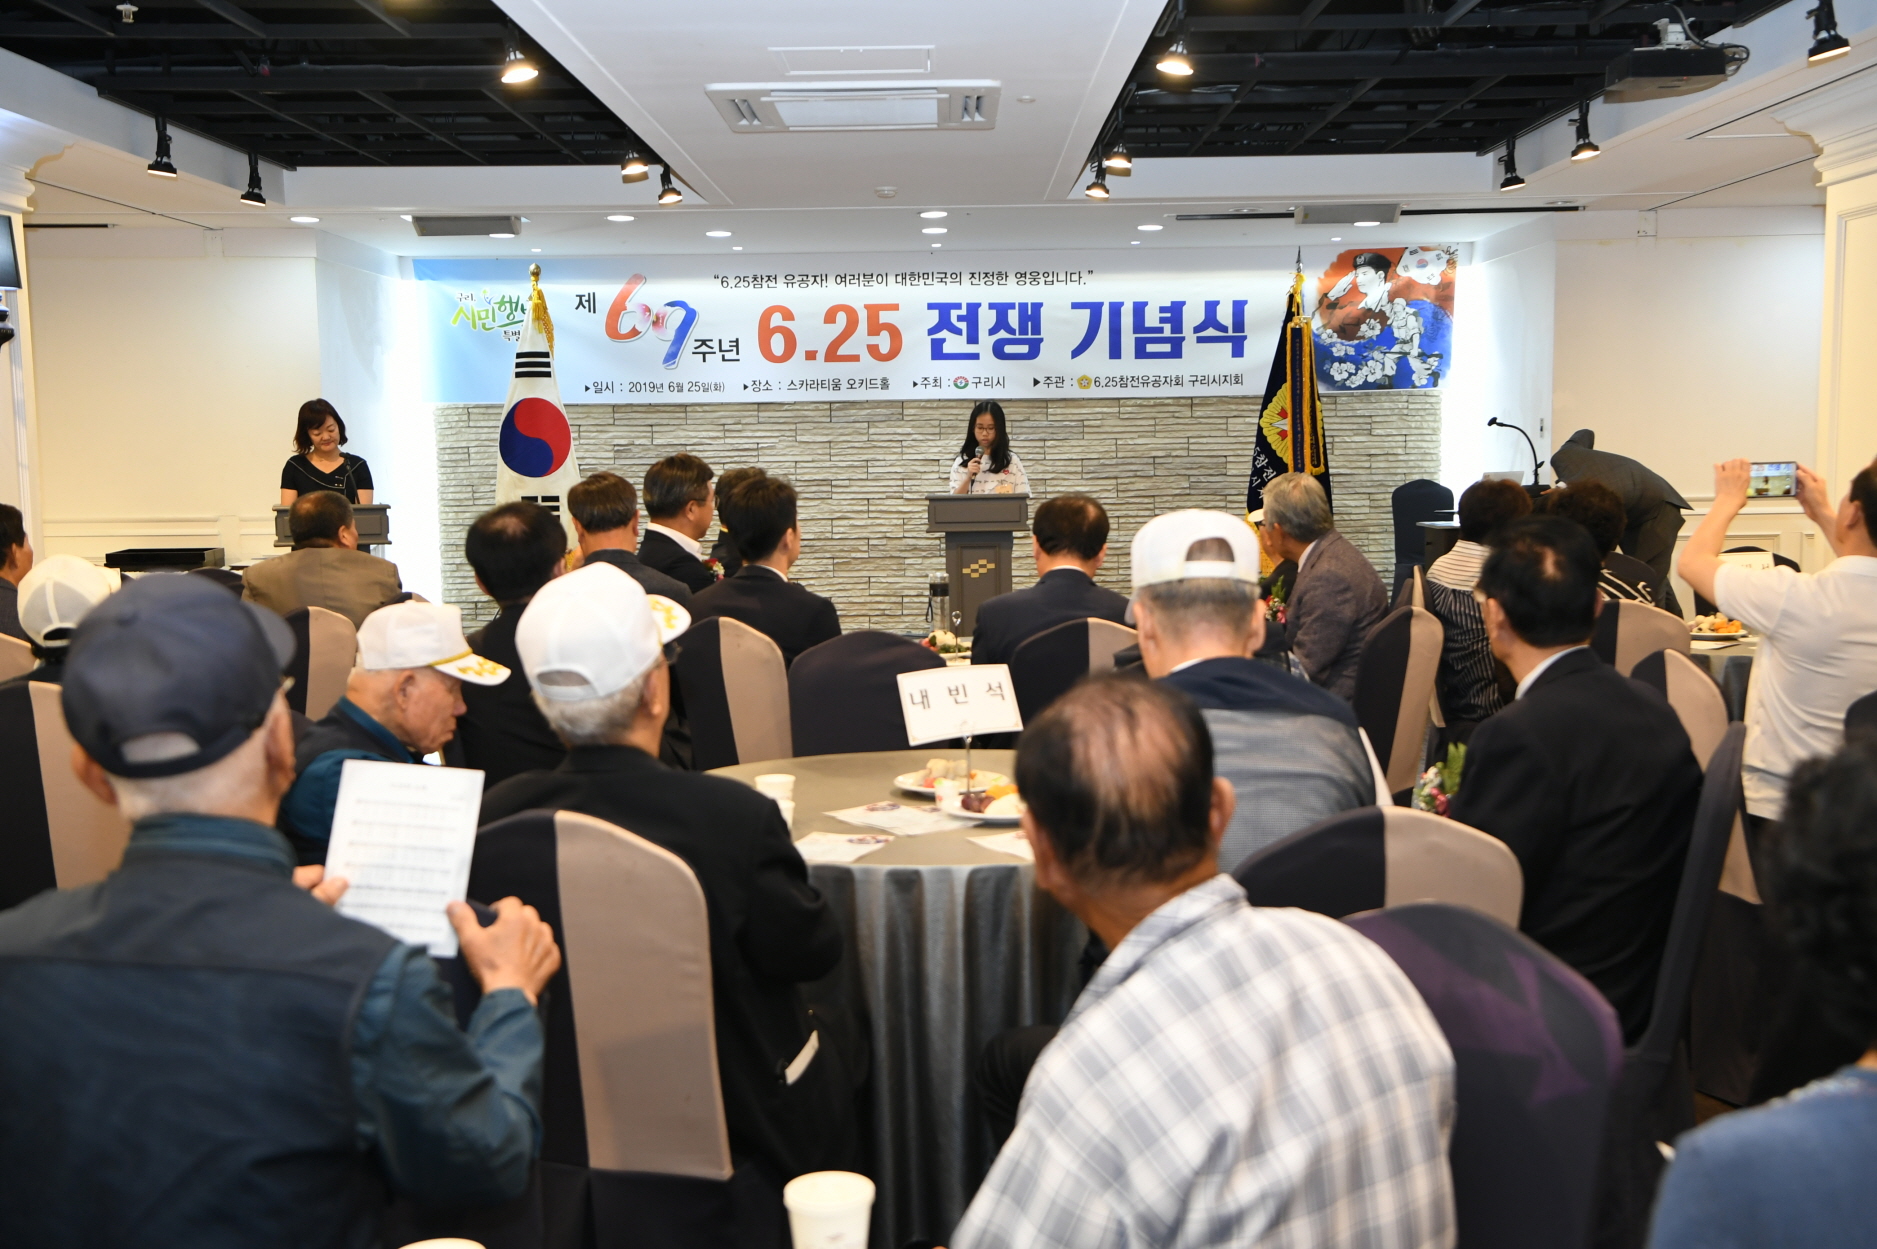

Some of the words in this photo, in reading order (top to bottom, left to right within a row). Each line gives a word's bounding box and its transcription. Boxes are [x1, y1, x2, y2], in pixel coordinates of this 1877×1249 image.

[783, 273, 828, 289] 유공자!
[834, 272, 888, 288] 여러분이
[895, 271, 962, 287] 대한민국의
[968, 271, 1009, 287] 진정한
[757, 303, 903, 363] 6.25
[927, 302, 1044, 361] 전쟁
[1070, 300, 1248, 360] 기념식
[628, 381, 664, 393] 2019년
[668, 381, 684, 393] 6월
[687, 381, 725, 393] 25일(화)
[787, 378, 842, 391] 스카라티움
[846, 376, 890, 391] 오키드홀
[971, 376, 1006, 390] 구리시
[1094, 374, 1184, 389] 6.25참전유공자회
[1188, 373, 1244, 388] 구리시지회
